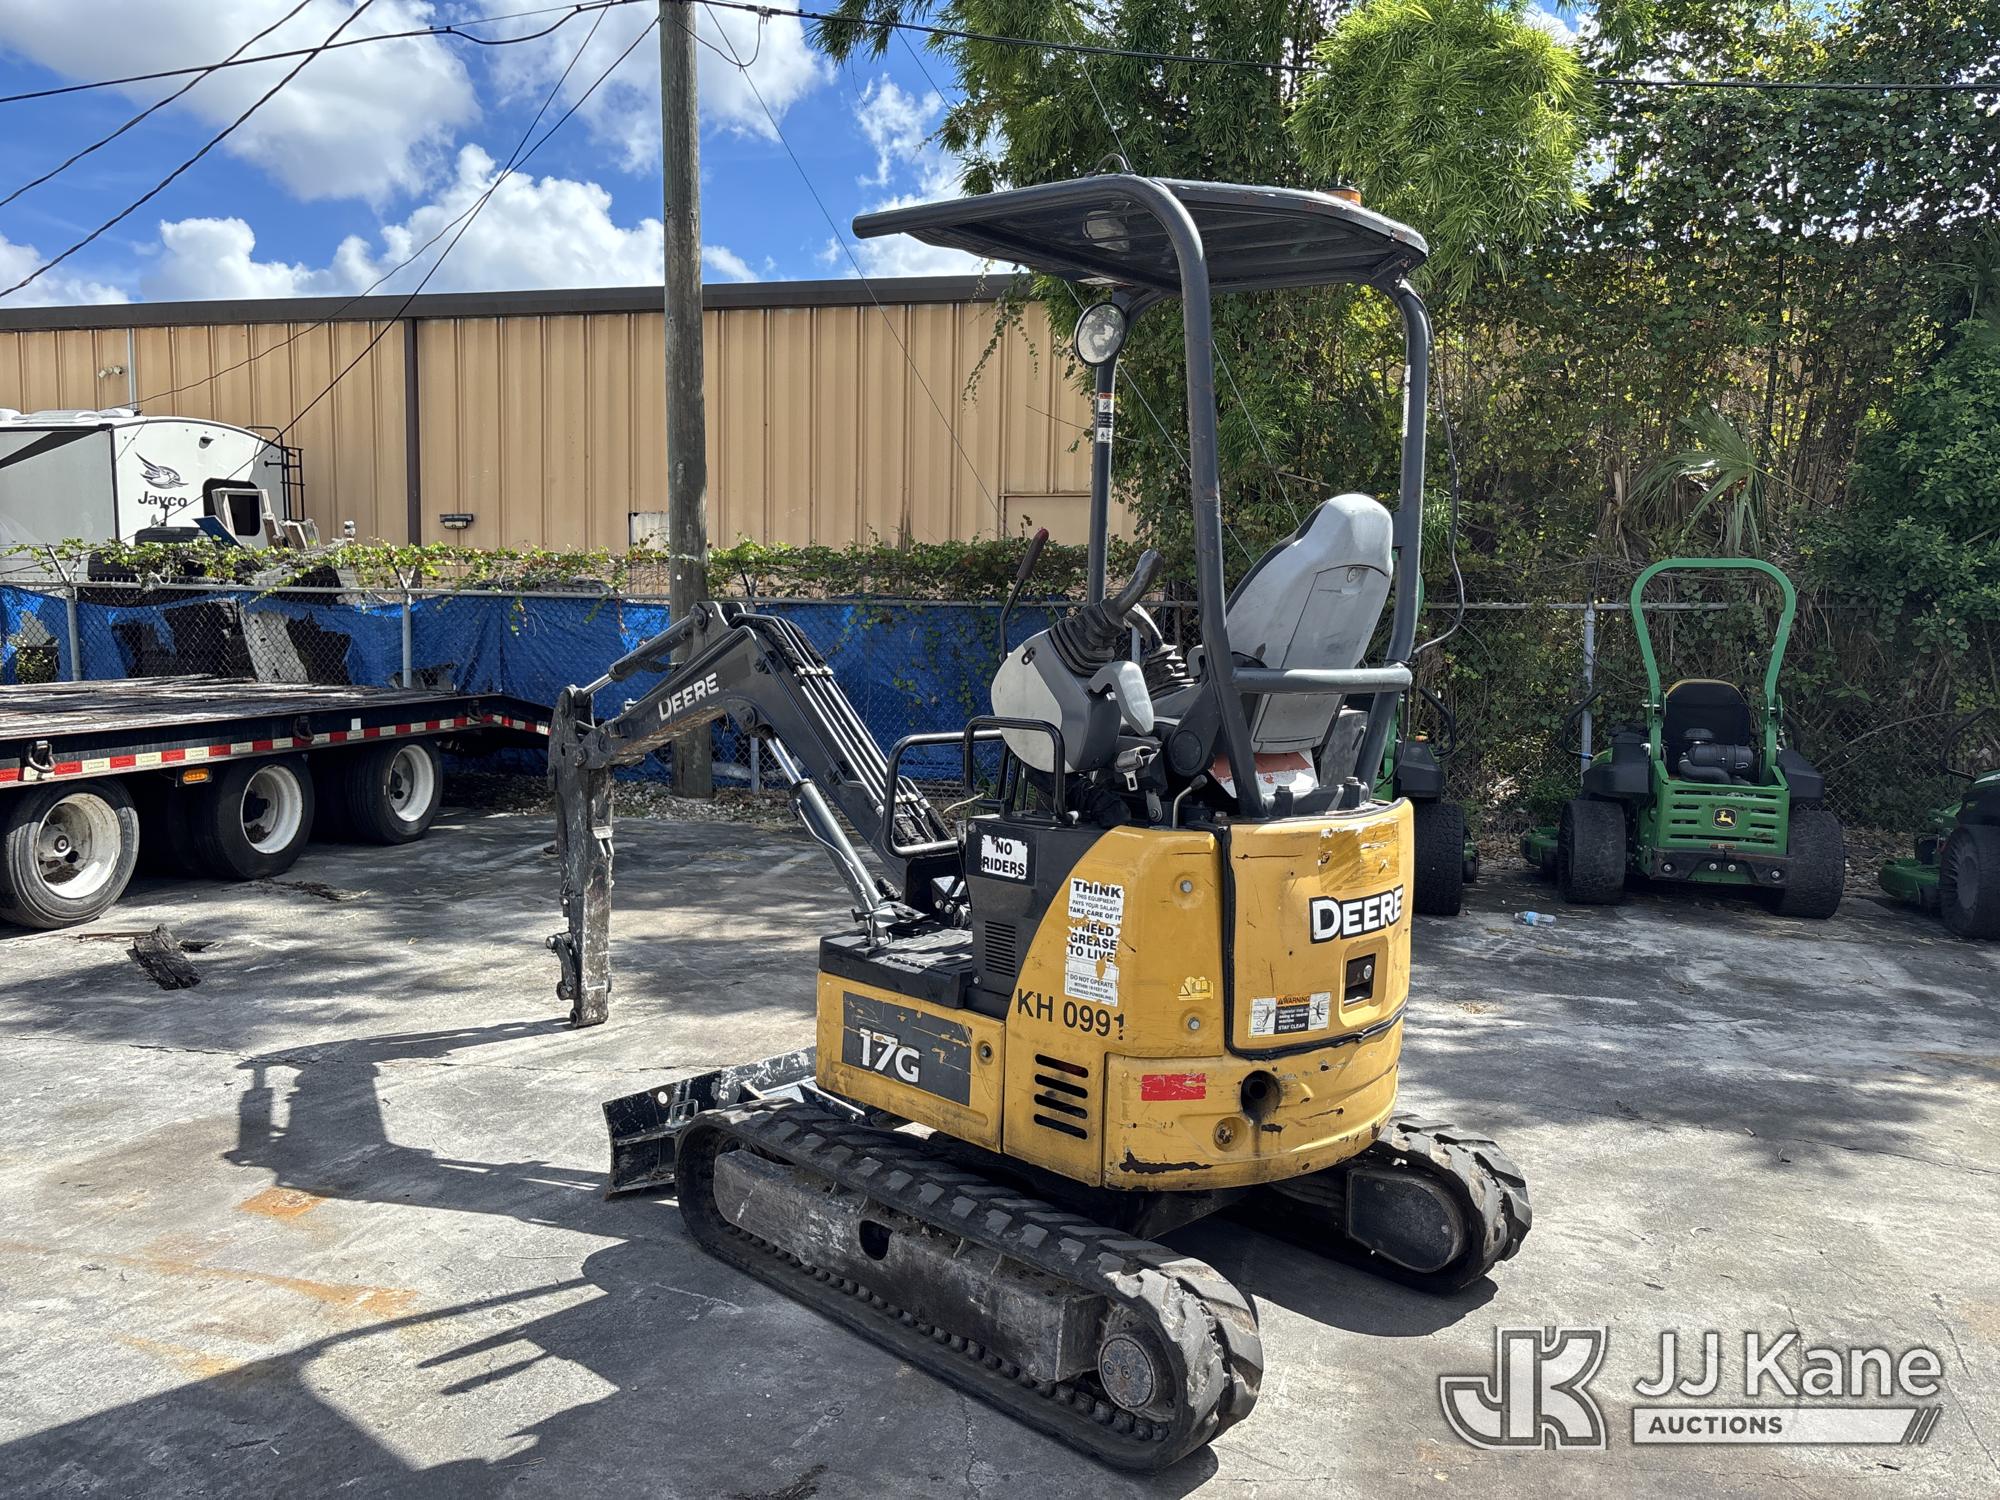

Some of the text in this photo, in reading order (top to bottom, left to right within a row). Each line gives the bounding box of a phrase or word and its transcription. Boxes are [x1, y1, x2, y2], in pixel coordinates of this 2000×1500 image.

[138, 491, 188, 509] Jayco
[658, 672, 720, 721] DEERE
[995, 841, 1012, 855] NO
[982, 855, 1025, 876] RIDERS
[1073, 881, 1122, 899] THINK
[1071, 899, 1085, 907] PAYS
[1100, 904, 1120, 912] SALARY
[1076, 893, 1117, 905] THIS EQUIPMENT
[1069, 906, 1085, 915] TAKE
[1086, 909, 1103, 918] CARE
[1309, 884, 1404, 943] DEERE
[1082, 922, 1114, 937] NEED
[1070, 932, 1118, 951] GREASE
[1068, 944, 1084, 957] TO
[1090, 978, 1114, 988] OPERATE
[1283, 996, 1310, 1005] WARNING
[1017, 988, 1124, 1040] KH 0991
[860, 1027, 920, 1083] 17G
